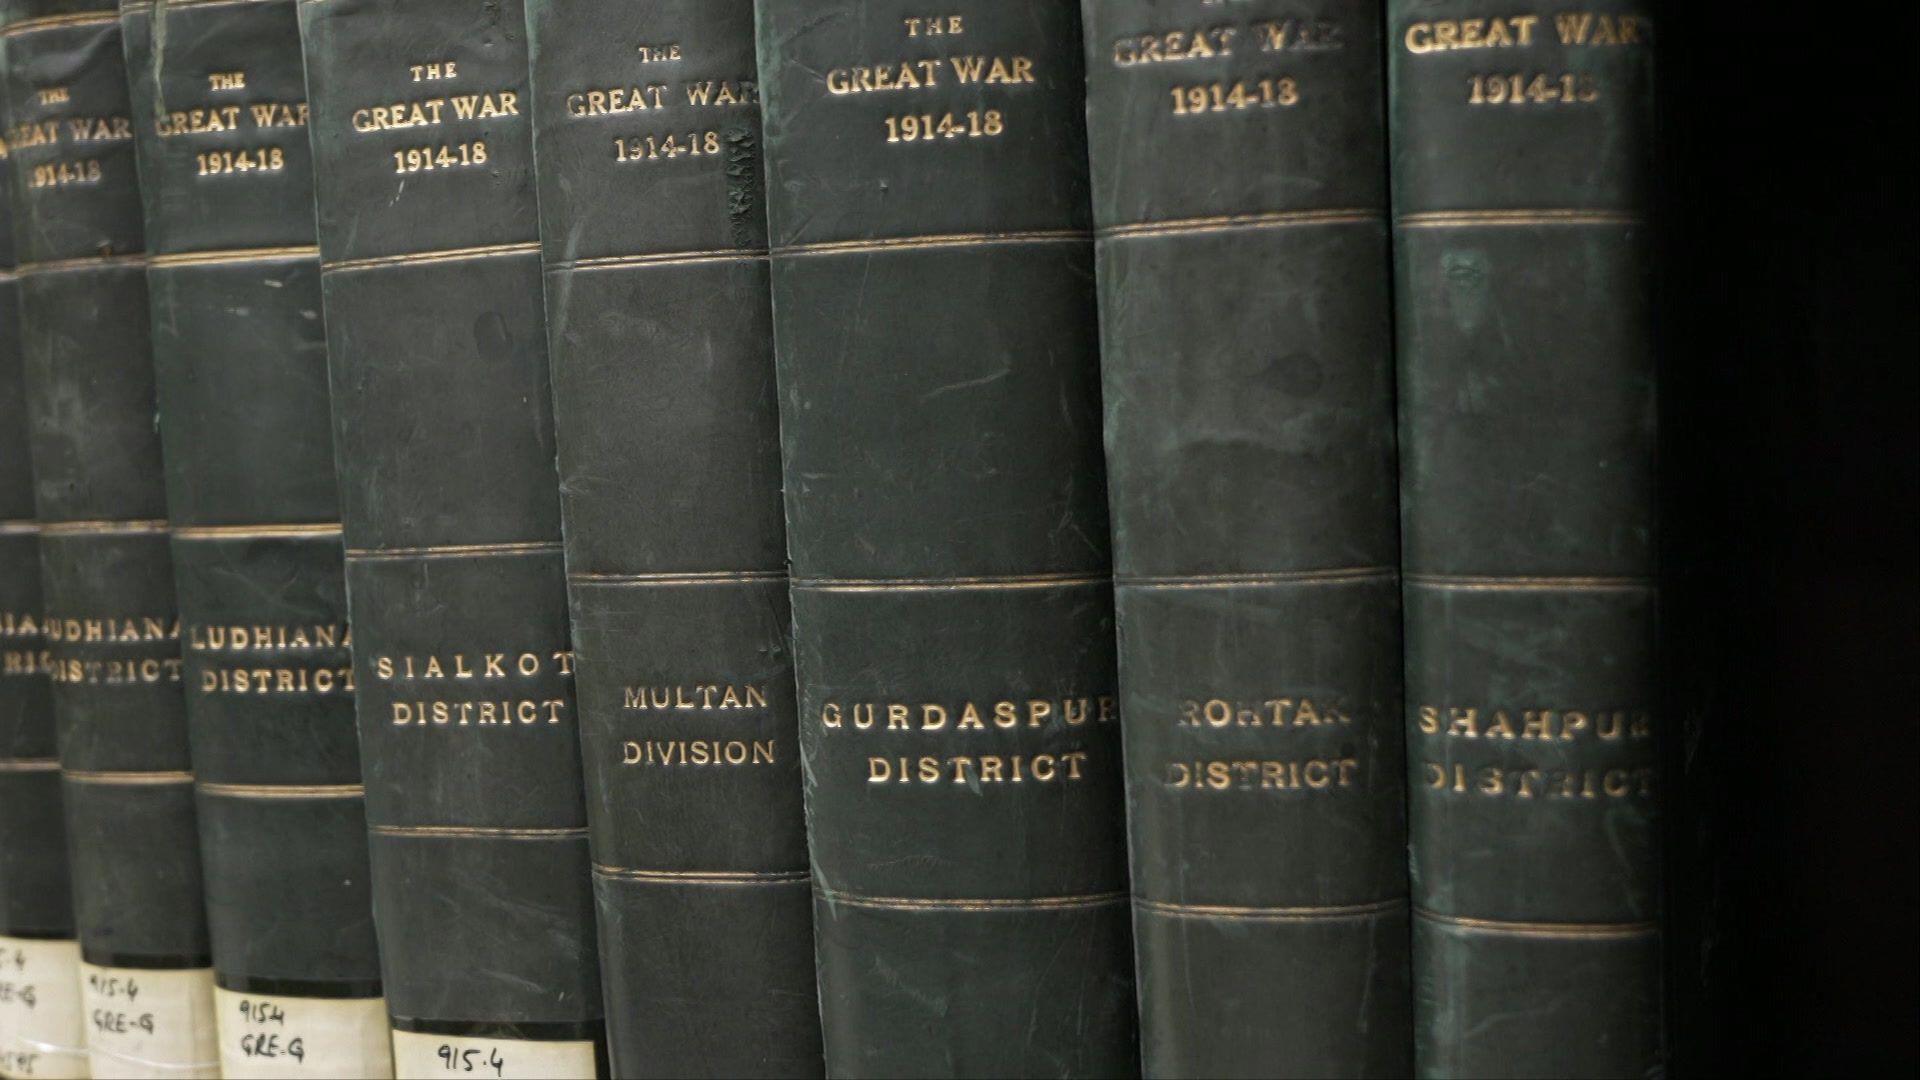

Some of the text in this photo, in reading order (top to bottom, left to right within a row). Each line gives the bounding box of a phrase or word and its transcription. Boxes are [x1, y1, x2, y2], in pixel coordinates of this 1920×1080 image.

[906, 16, 964, 36] THE
[1405, 14, 1538, 53] GREAT
[639, 44, 681, 64] THE
[209, 72, 245, 91] THE
[410, 62, 457, 82] THE
[827, 55, 1035, 95] GREAT WAR
[352, 91, 519, 132] GREAT WAR
[566, 85, 667, 119] GREAT
[70, 117, 132, 141] WAR
[155, 106, 240, 136] GREAT
[884, 110, 1005, 143] 1914-18
[393, 141, 488, 174] 1914-18
[614, 130, 720, 163] 1914-18
[28, 160, 101, 188] 914-18
[196, 148, 284, 176] 1914-18
[376, 652, 575, 680] SIALKOT
[201, 667, 356, 694] DISTRICT
[622, 684, 768, 711] MULTAN
[392, 699, 565, 725] DISTRICT
[622, 739, 776, 766] DIVISION
[867, 754, 1086, 783] DISTRICT
[1165, 758, 1358, 791] DISTRICT
[437, 1044, 504, 1077] 915.4
